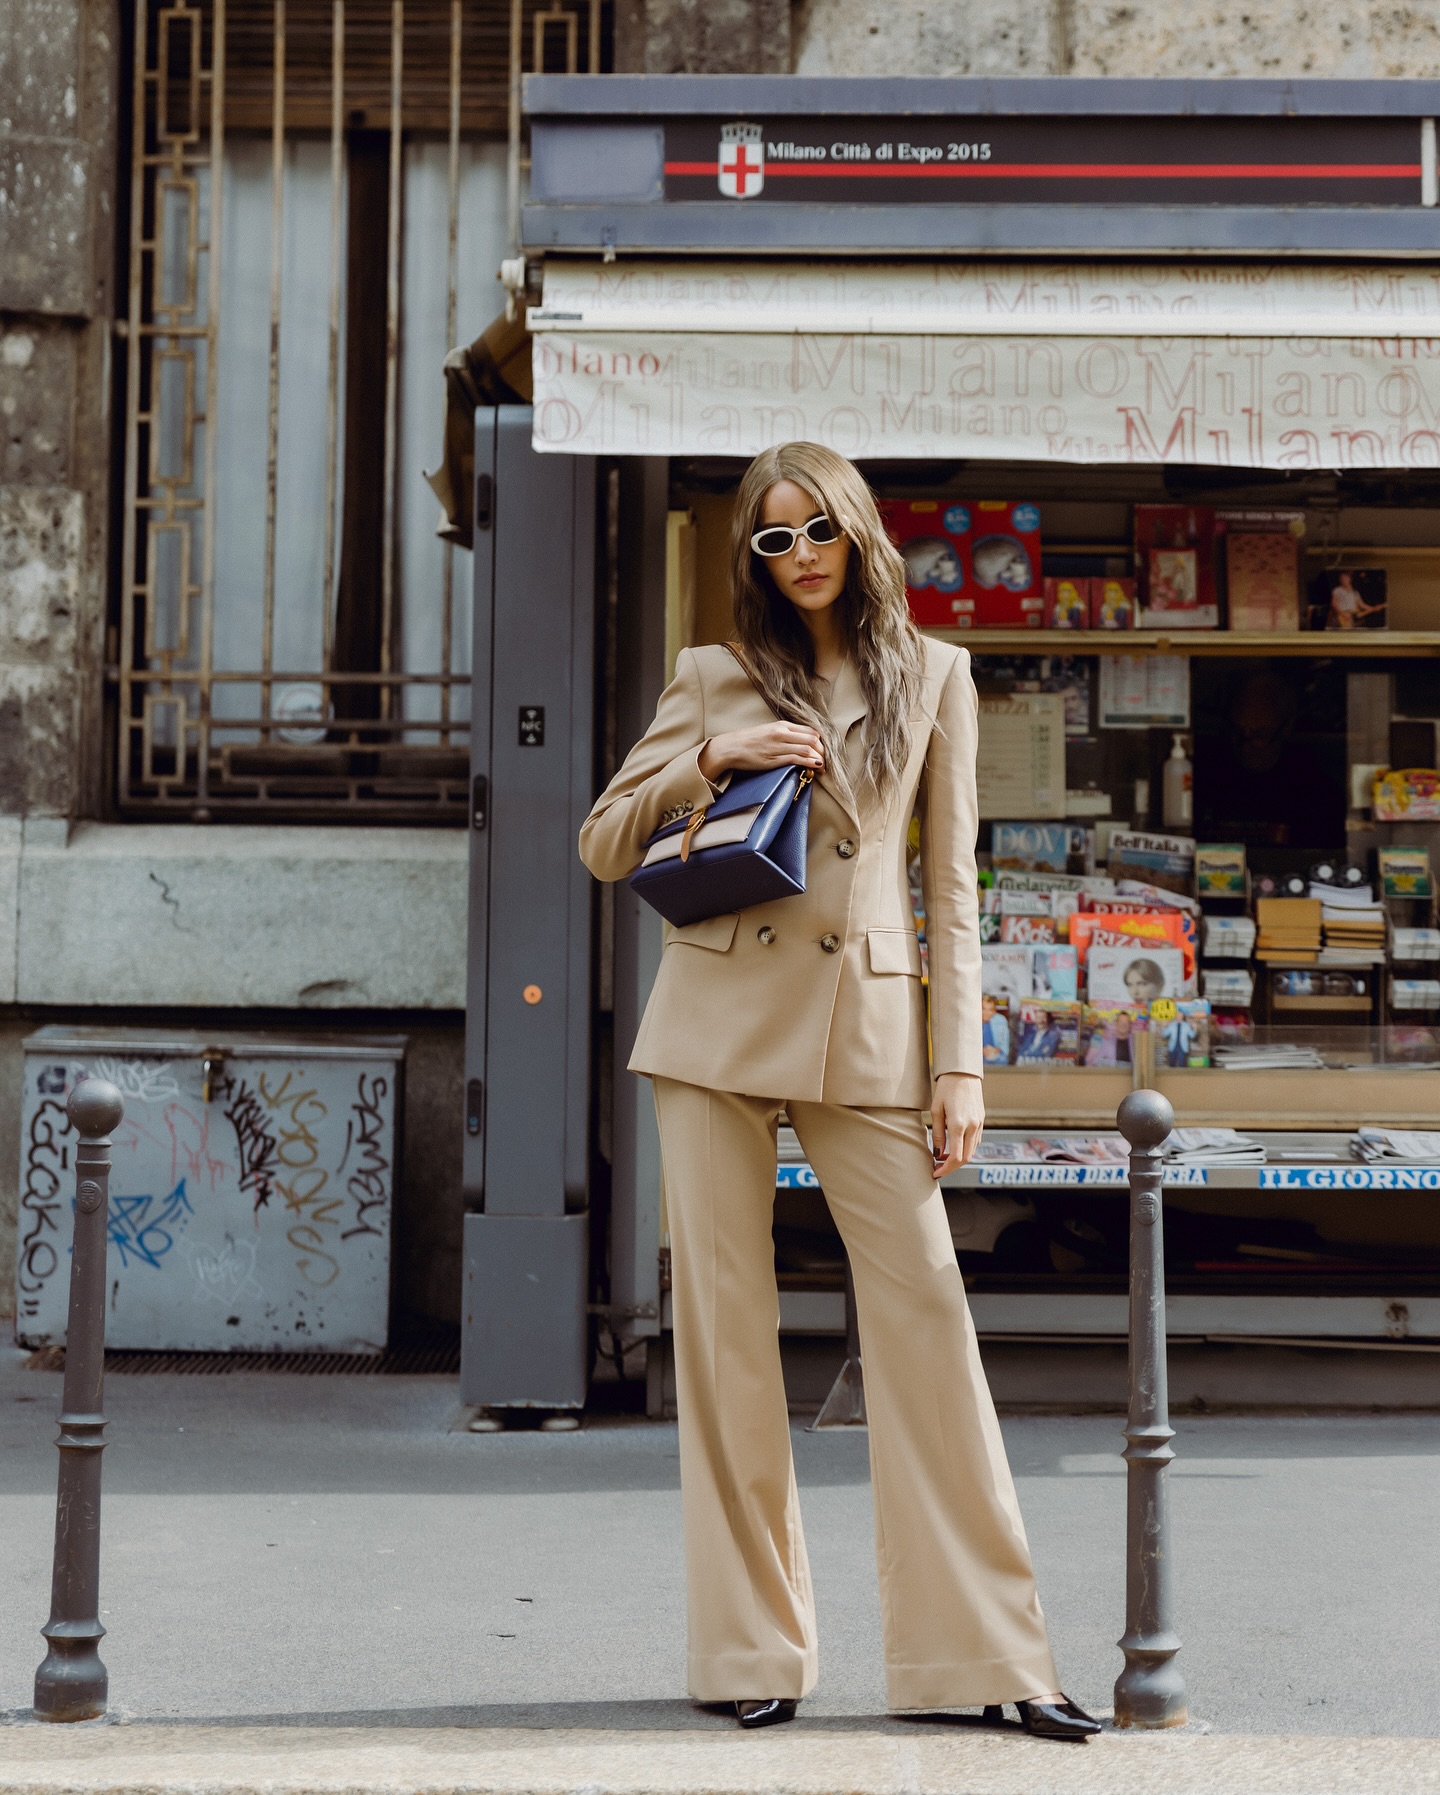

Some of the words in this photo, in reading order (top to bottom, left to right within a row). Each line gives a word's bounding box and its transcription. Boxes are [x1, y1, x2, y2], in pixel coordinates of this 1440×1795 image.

[767, 142, 827, 161] Milano
[830, 142, 872, 161] Città
[875, 142, 893, 161] di
[898, 142, 944, 165] Expo
[947, 143, 992, 161] 2015
[594, 270, 750, 301] Milano
[791, 333, 1131, 399] Milano
[1137, 352, 1422, 419] Milano
[546, 380, 873, 455] Milano
[877, 390, 1068, 438] Milano
[1117, 405, 1440, 467] Milano
[521, 721, 542, 731] NFC
[1006, 917, 1055, 943] Kids
[1092, 929, 1142, 949] RIZA
[980, 1167, 1081, 1185] CORRIERE
[1083, 1167, 1131, 1185] DEL
[1162, 1167, 1207, 1185] ERA
[1262, 1168, 1301, 1189] IL
[1306, 1168, 1440, 1190] GIORNO
